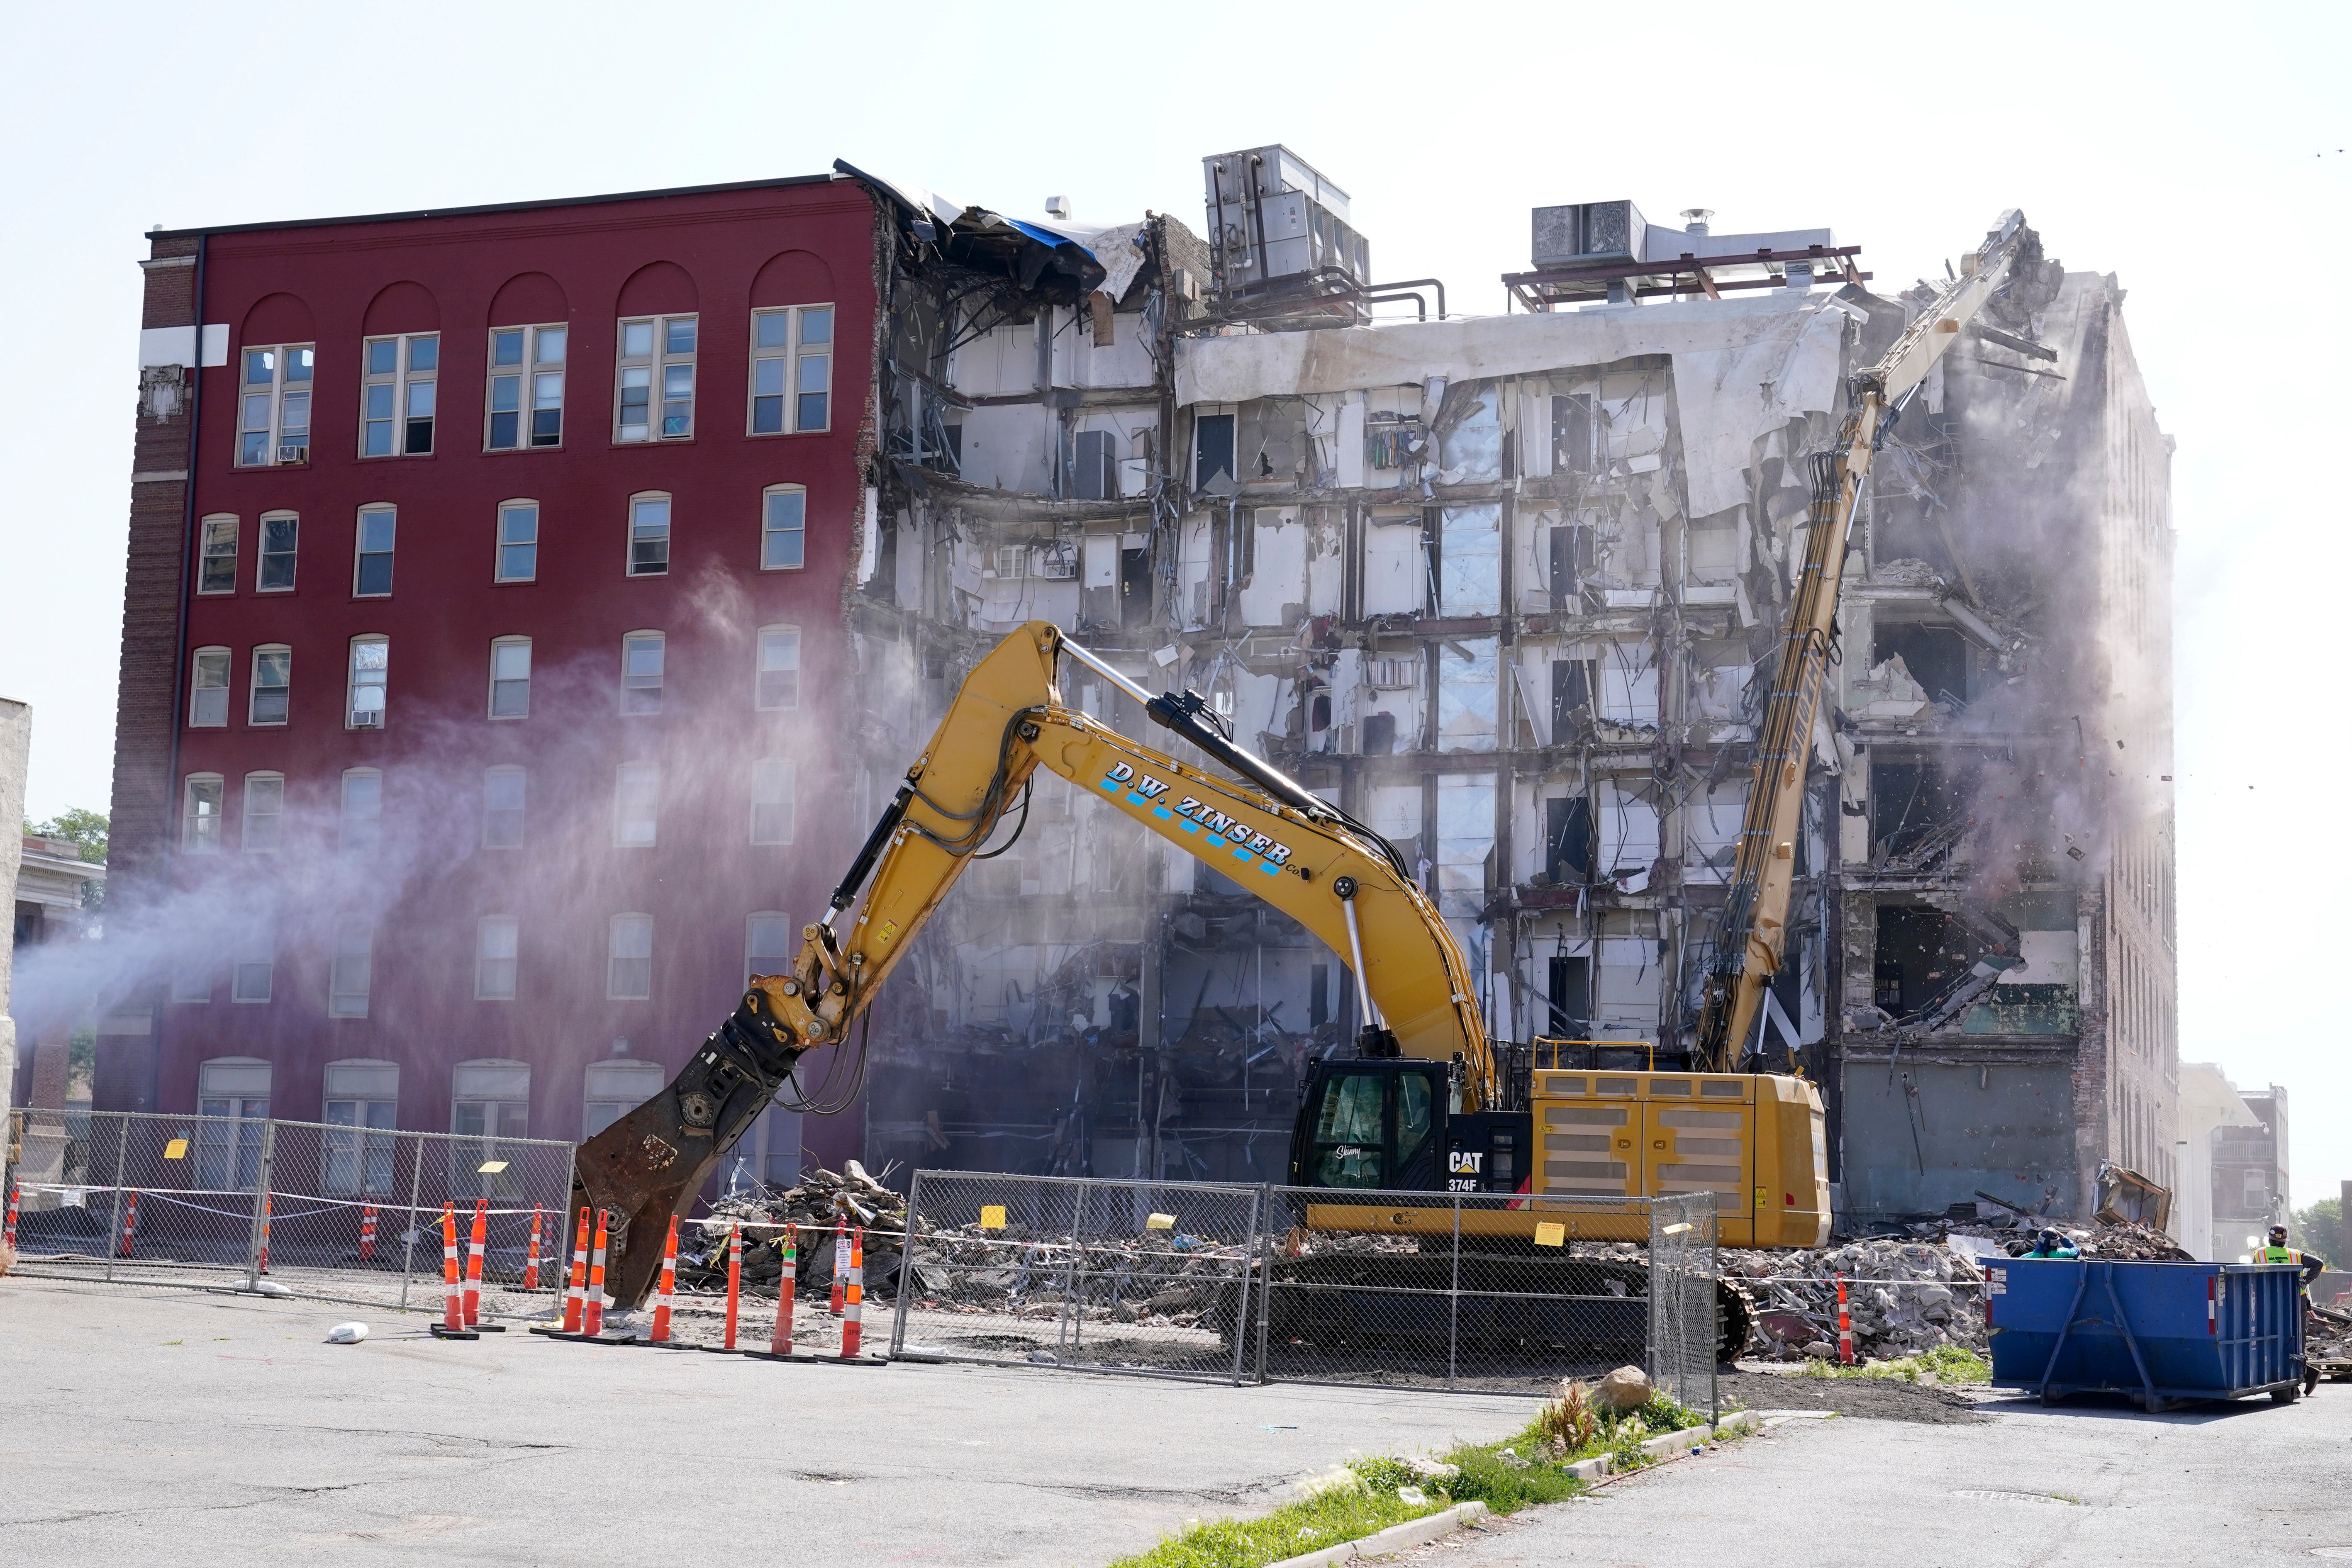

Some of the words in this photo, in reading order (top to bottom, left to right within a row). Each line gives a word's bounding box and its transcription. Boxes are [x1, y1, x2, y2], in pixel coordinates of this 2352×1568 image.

[1106, 760, 1171, 805] D.W.
[1173, 795, 1292, 866] ZINSER
[1285, 864, 1300, 876] Co.
[1336, 1145, 1361, 1159] Skinny
[1449, 1152, 1483, 1173] CAT
[1448, 1179, 1477, 1191] 374F
[1481, 1183, 1487, 1192] L
